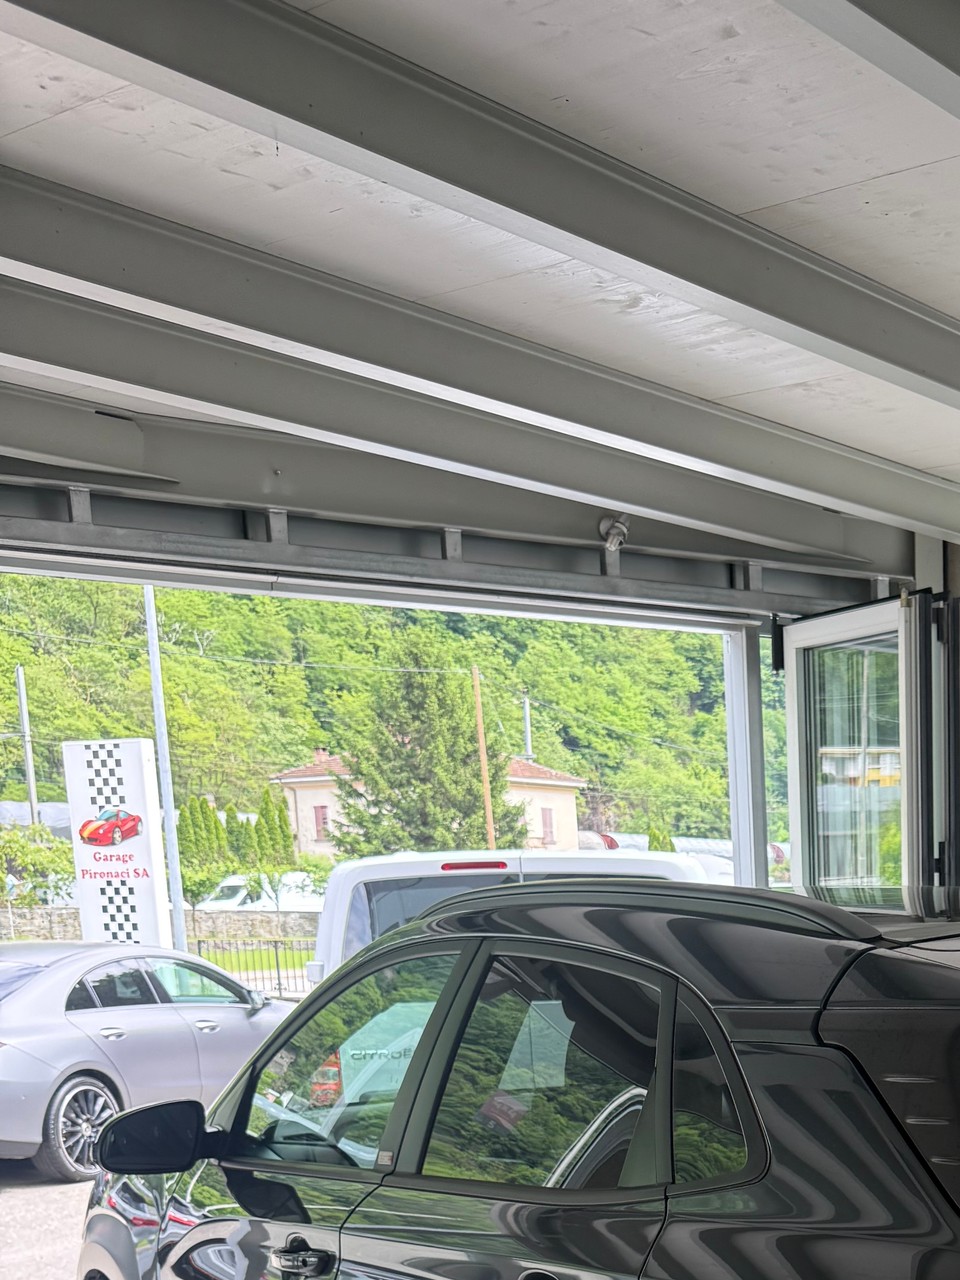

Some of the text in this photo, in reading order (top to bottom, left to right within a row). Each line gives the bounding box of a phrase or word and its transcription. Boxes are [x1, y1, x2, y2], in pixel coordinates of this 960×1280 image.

[93, 851, 135, 864] Garage
[81, 867, 150, 879] Pironaci SA
[350, 1047, 413, 1061] CITROË
